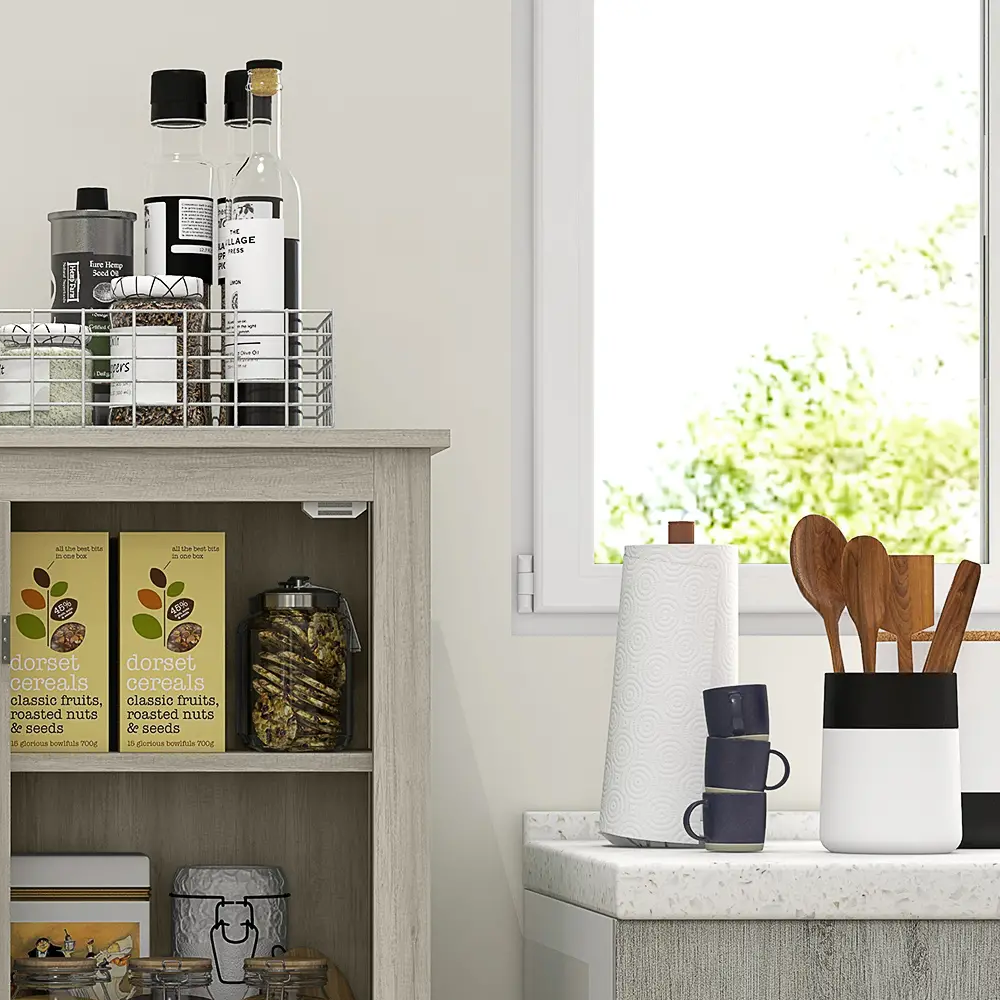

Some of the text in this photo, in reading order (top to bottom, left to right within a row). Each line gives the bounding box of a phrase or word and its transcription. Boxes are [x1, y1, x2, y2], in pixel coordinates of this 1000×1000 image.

[105, 261, 123, 270] Hemp
[10, 654, 80, 671] dorset
[126, 654, 196, 671] dorset
[10, 674, 88, 691] cereals
[126, 674, 205, 691] cereals
[10, 695, 102, 708] classic fruits,
[127, 695, 219, 708] classic fruits,
[10, 709, 98, 719] roasted nuts
[127, 709, 214, 719] roasted nuts
[10, 723, 64, 733] & seeds
[127, 723, 180, 733] & seeds
[20, 740, 48, 748] glorious
[81, 740, 98, 748] 700g
[136, 740, 164, 748] glorious
[197, 740, 214, 748] 700g
